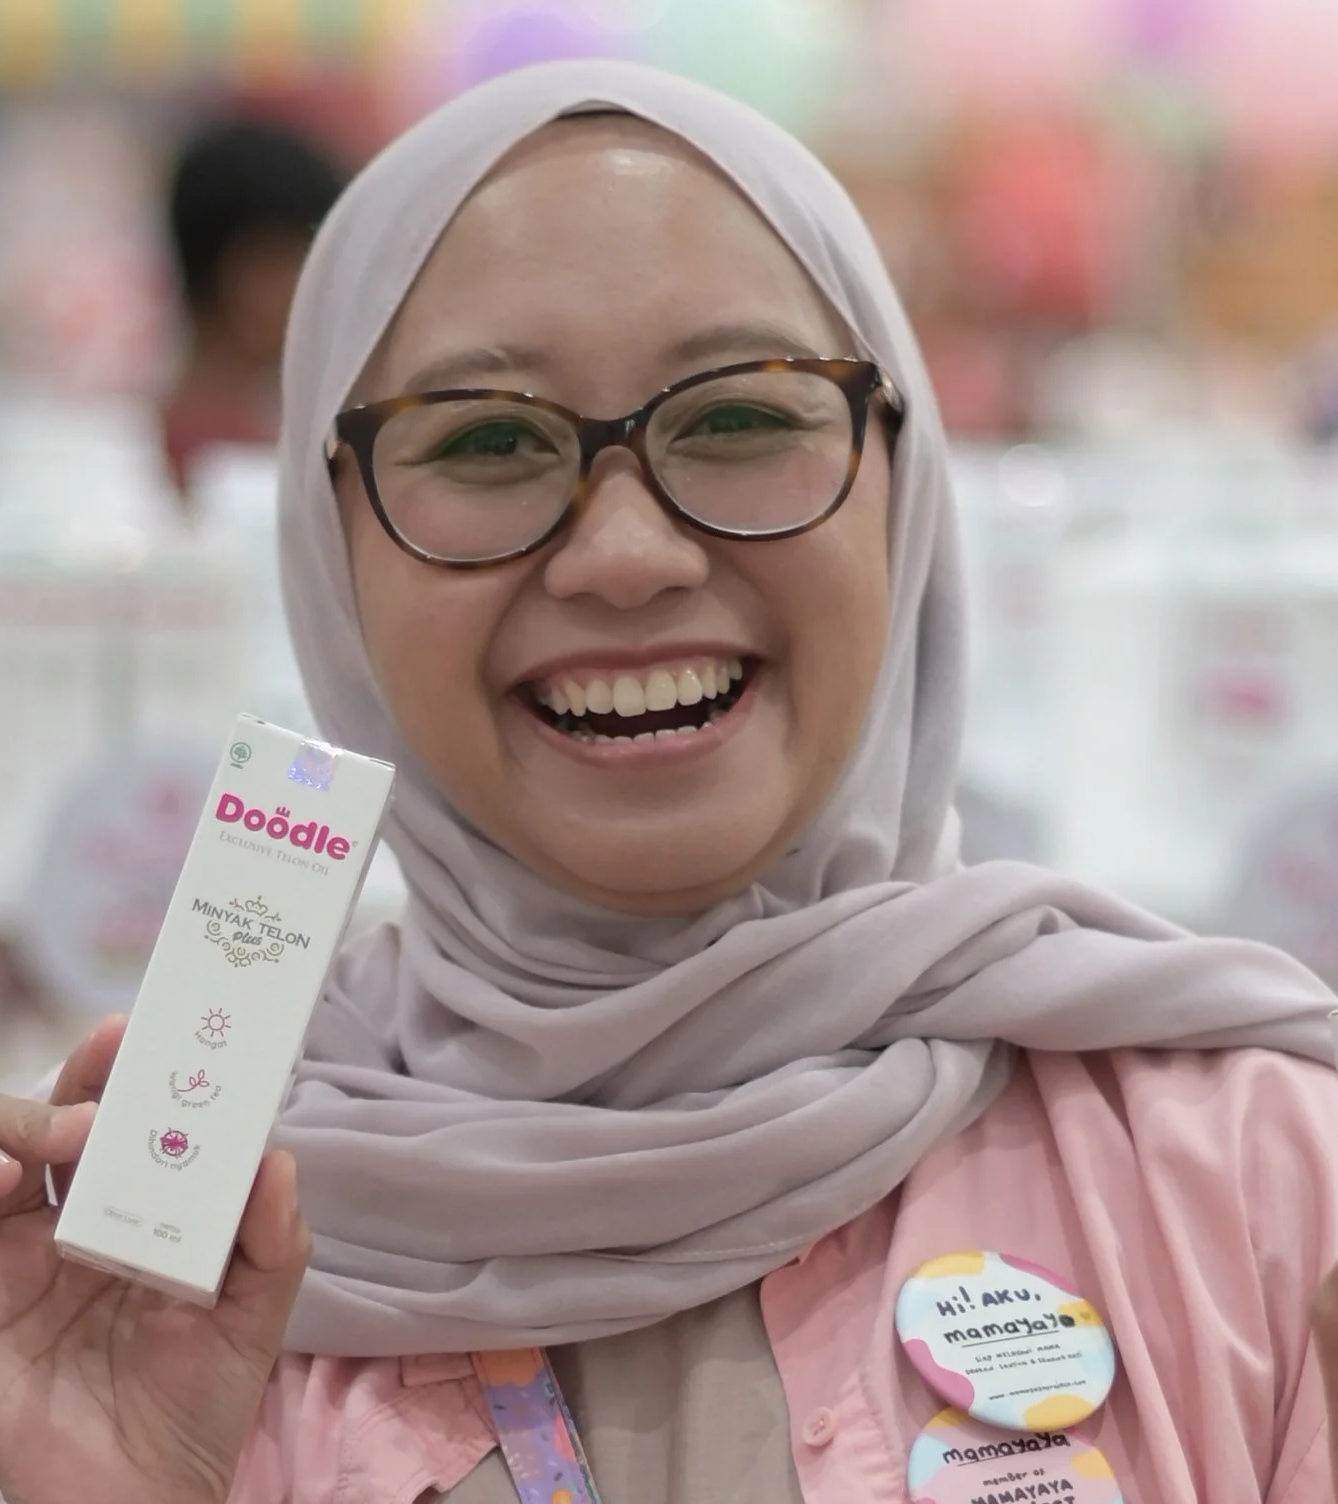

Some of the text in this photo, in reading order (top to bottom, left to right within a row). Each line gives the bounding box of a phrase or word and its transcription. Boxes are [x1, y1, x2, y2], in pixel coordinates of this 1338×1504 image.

[192, 898, 311, 949] MINYAK TELON
[194, 1031, 228, 1050] Hangat
[936, 1286, 975, 1316] Hi!
